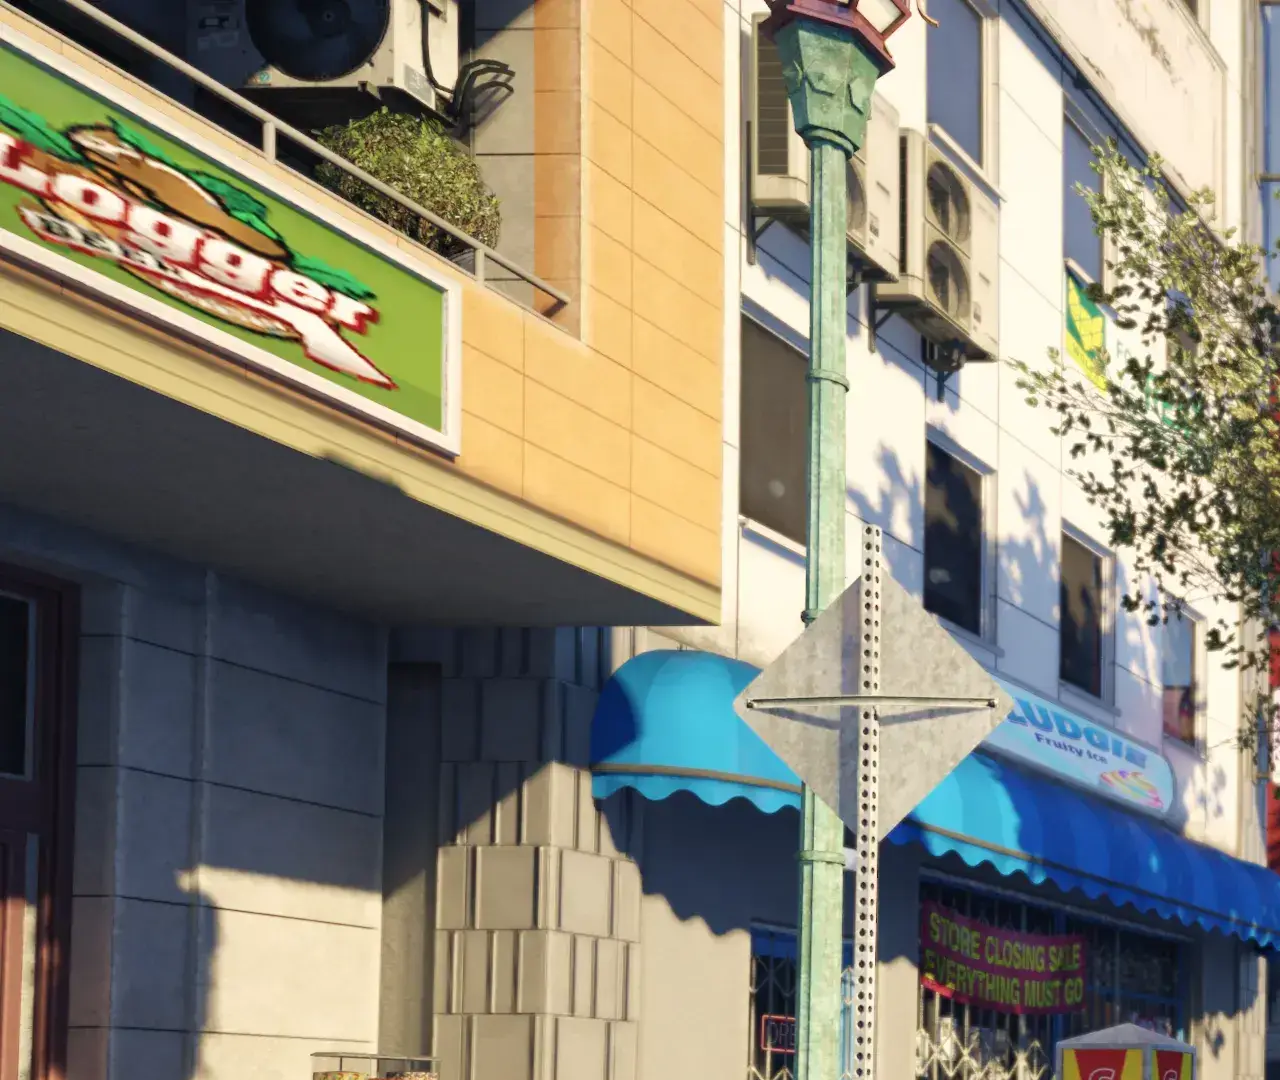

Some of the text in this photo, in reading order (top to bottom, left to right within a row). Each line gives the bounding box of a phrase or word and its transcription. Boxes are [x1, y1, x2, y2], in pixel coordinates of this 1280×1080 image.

[1007, 697, 1148, 770] LUDGIE
[1034, 732, 1109, 765] Fruity Ice
[929, 911, 1082, 974] STORE CLOSING SALE
[924, 948, 1085, 1009] EVERYTHING MUST GO
[767, 1021, 797, 1046] OPE
